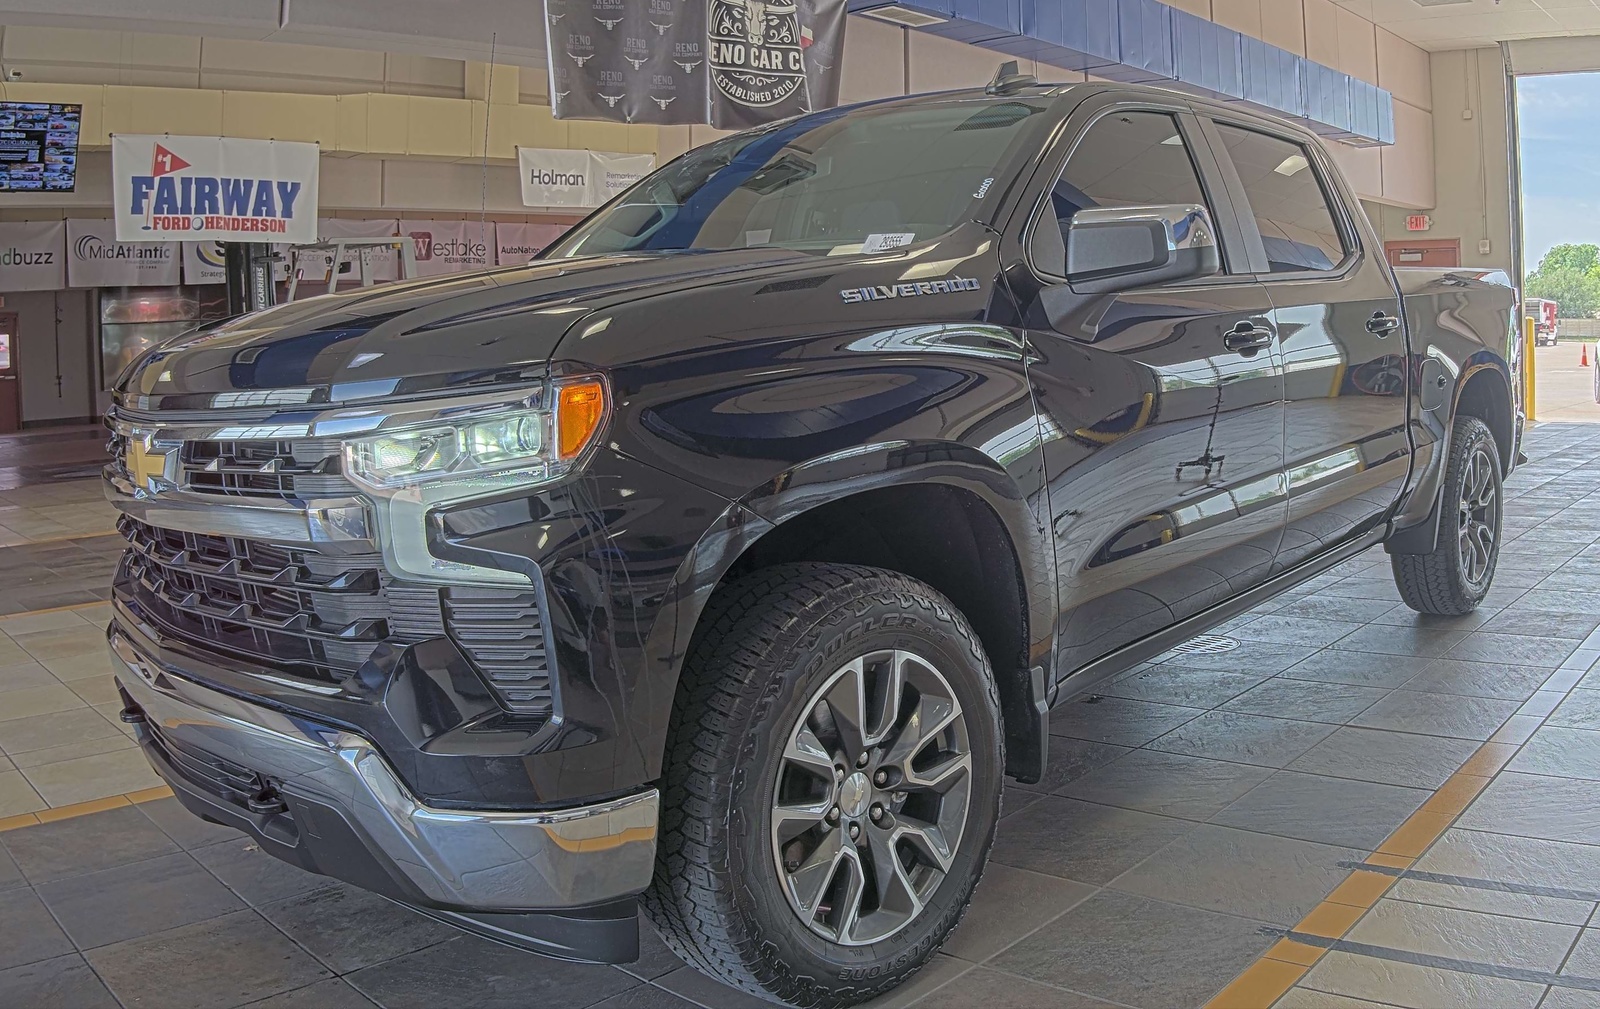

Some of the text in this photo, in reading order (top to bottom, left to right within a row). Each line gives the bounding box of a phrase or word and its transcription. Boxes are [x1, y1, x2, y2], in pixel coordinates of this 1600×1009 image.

[651, 1, 671, 11] RENO
[569, 34, 591, 46] RENO
[626, 38, 646, 49] RENO
[675, 43, 699, 53] RENO
[709, 41, 745, 65] ENO
[750, 47, 783, 70] CAR
[600, 71, 623, 82] RENO
[652, 75, 673, 85] RENO
[716, 75, 772, 102] ESTABLISHED
[772, 81, 794, 99] 2010
[157, 154, 172, 172] #1
[531, 169, 585, 186] Holman
[606, 172, 645, 181] Remarketin
[131, 176, 301, 218] FAIRWAY
[153, 216, 286, 233] FORD HENDERSON
[1409, 216, 1425, 229] EXIT
[89, 245, 170, 259] MidAtlantic
[413, 238, 486, 258] Westlake
[501, 246, 540, 254] AutoNation
[0, 248, 53, 265] dbuzz
[256, 266, 265, 302] CARRIERS
[839, 277, 981, 304] SILVERADO
